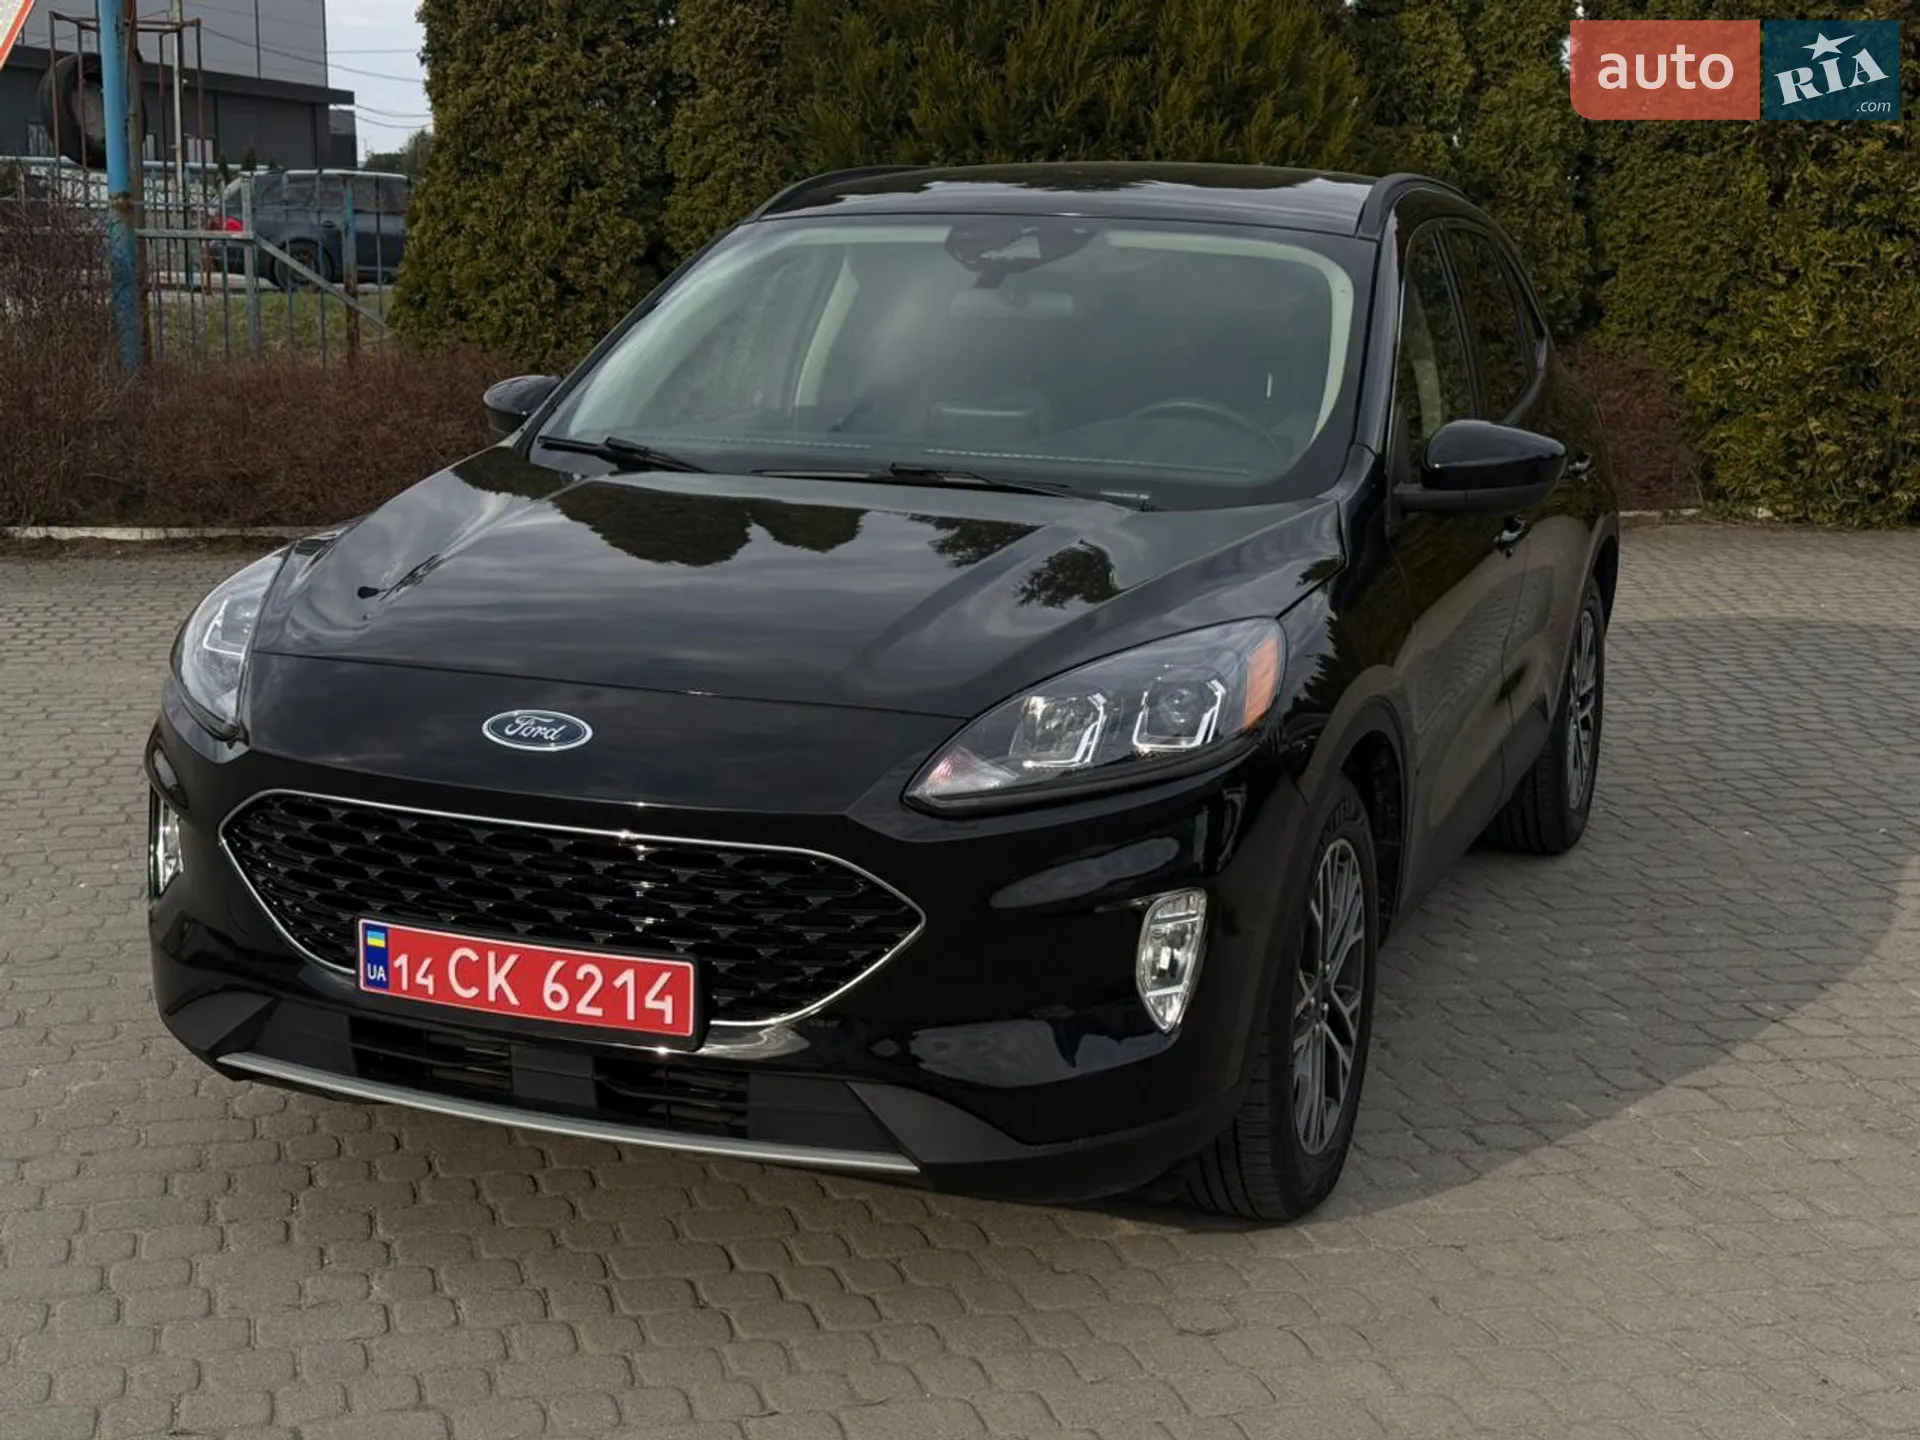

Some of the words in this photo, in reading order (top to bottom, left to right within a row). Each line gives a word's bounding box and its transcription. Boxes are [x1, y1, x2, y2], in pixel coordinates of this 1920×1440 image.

[504, 715, 567, 740] Ford
[367, 963, 386, 982] UA
[393, 954, 434, 995] 14
[448, 948, 520, 1006] CK
[543, 960, 673, 1025] 6214
